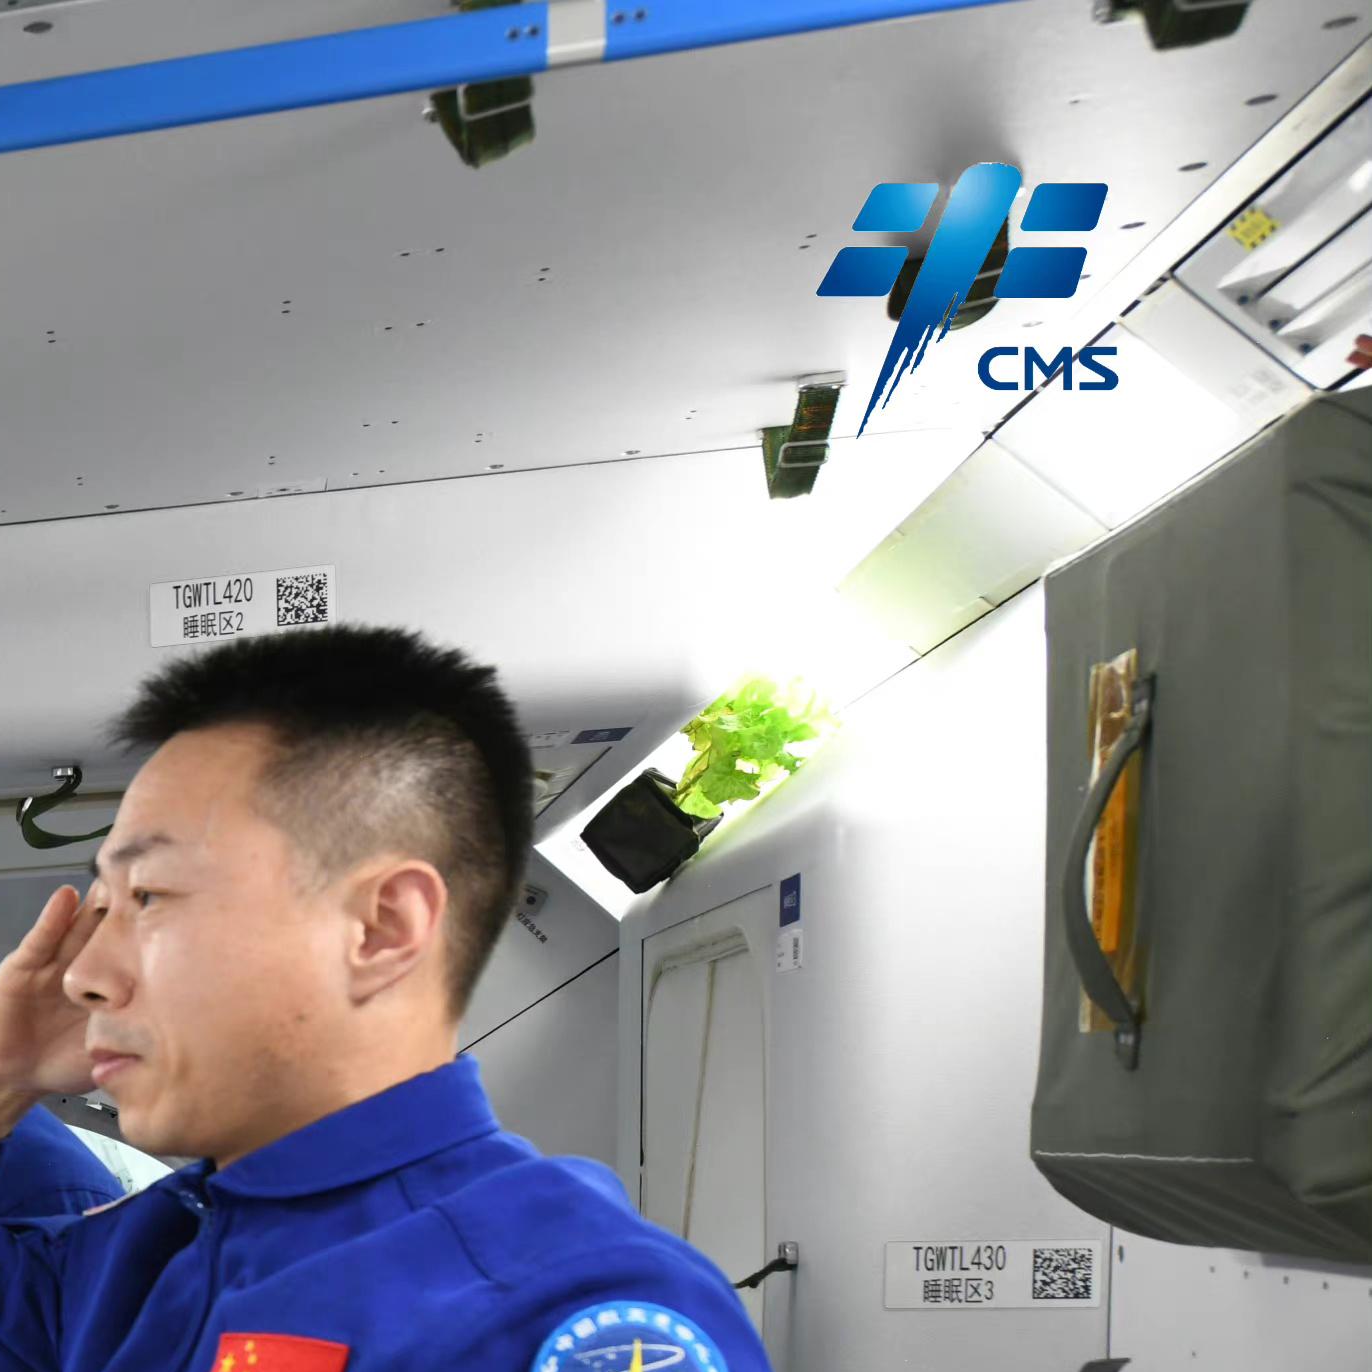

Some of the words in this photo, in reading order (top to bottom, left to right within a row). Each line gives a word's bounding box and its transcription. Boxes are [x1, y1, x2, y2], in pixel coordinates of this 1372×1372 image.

[173, 578, 254, 610] TGWTL420
[183, 611, 244, 639] 睡眠区2
[913, 1245, 1006, 1271] TGWTL430
[922, 1277, 995, 1304] 睡眠区3
